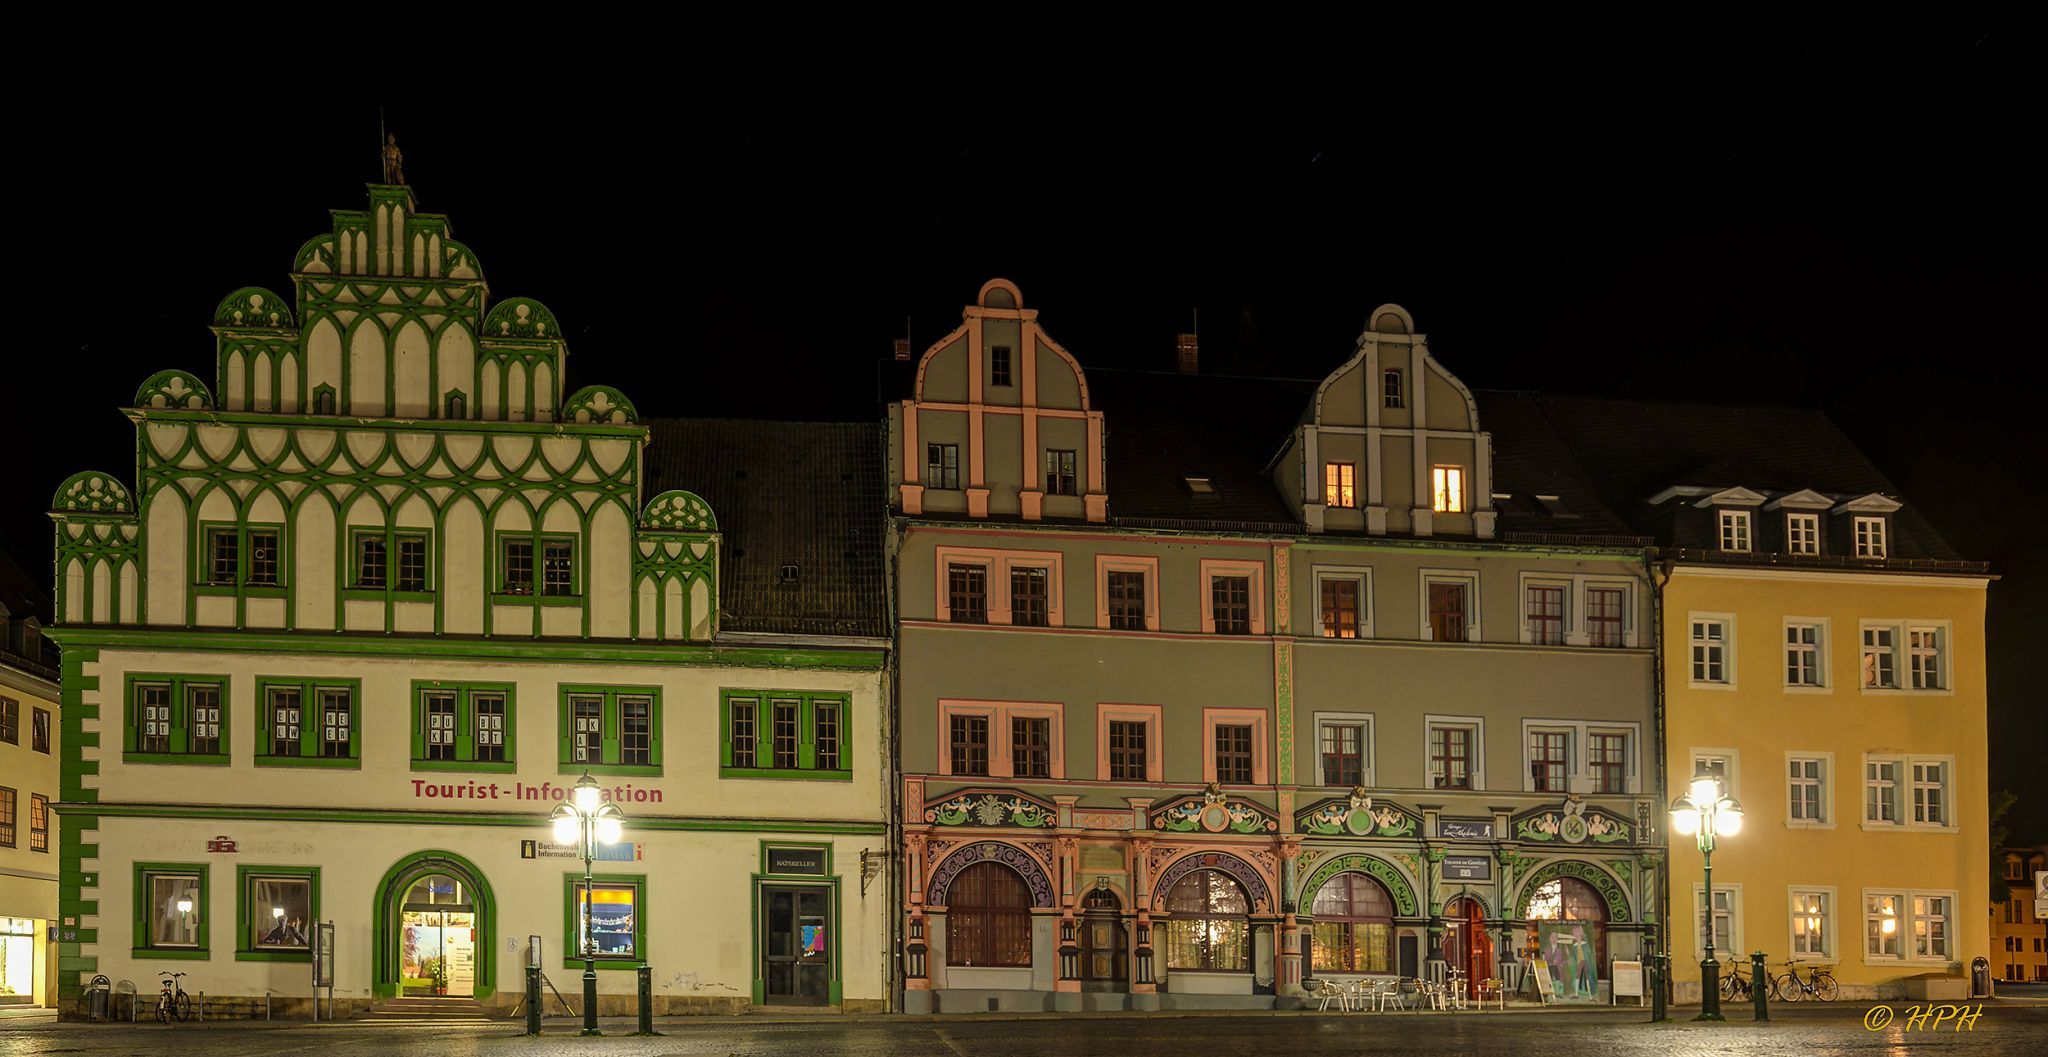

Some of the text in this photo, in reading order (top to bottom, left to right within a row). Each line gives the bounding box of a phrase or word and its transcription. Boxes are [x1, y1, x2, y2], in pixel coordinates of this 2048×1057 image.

[411, 779, 663, 803] Tourist-Inforation
[538, 850, 577, 858] Information
[776, 860, 816, 868] RATSKELLER
